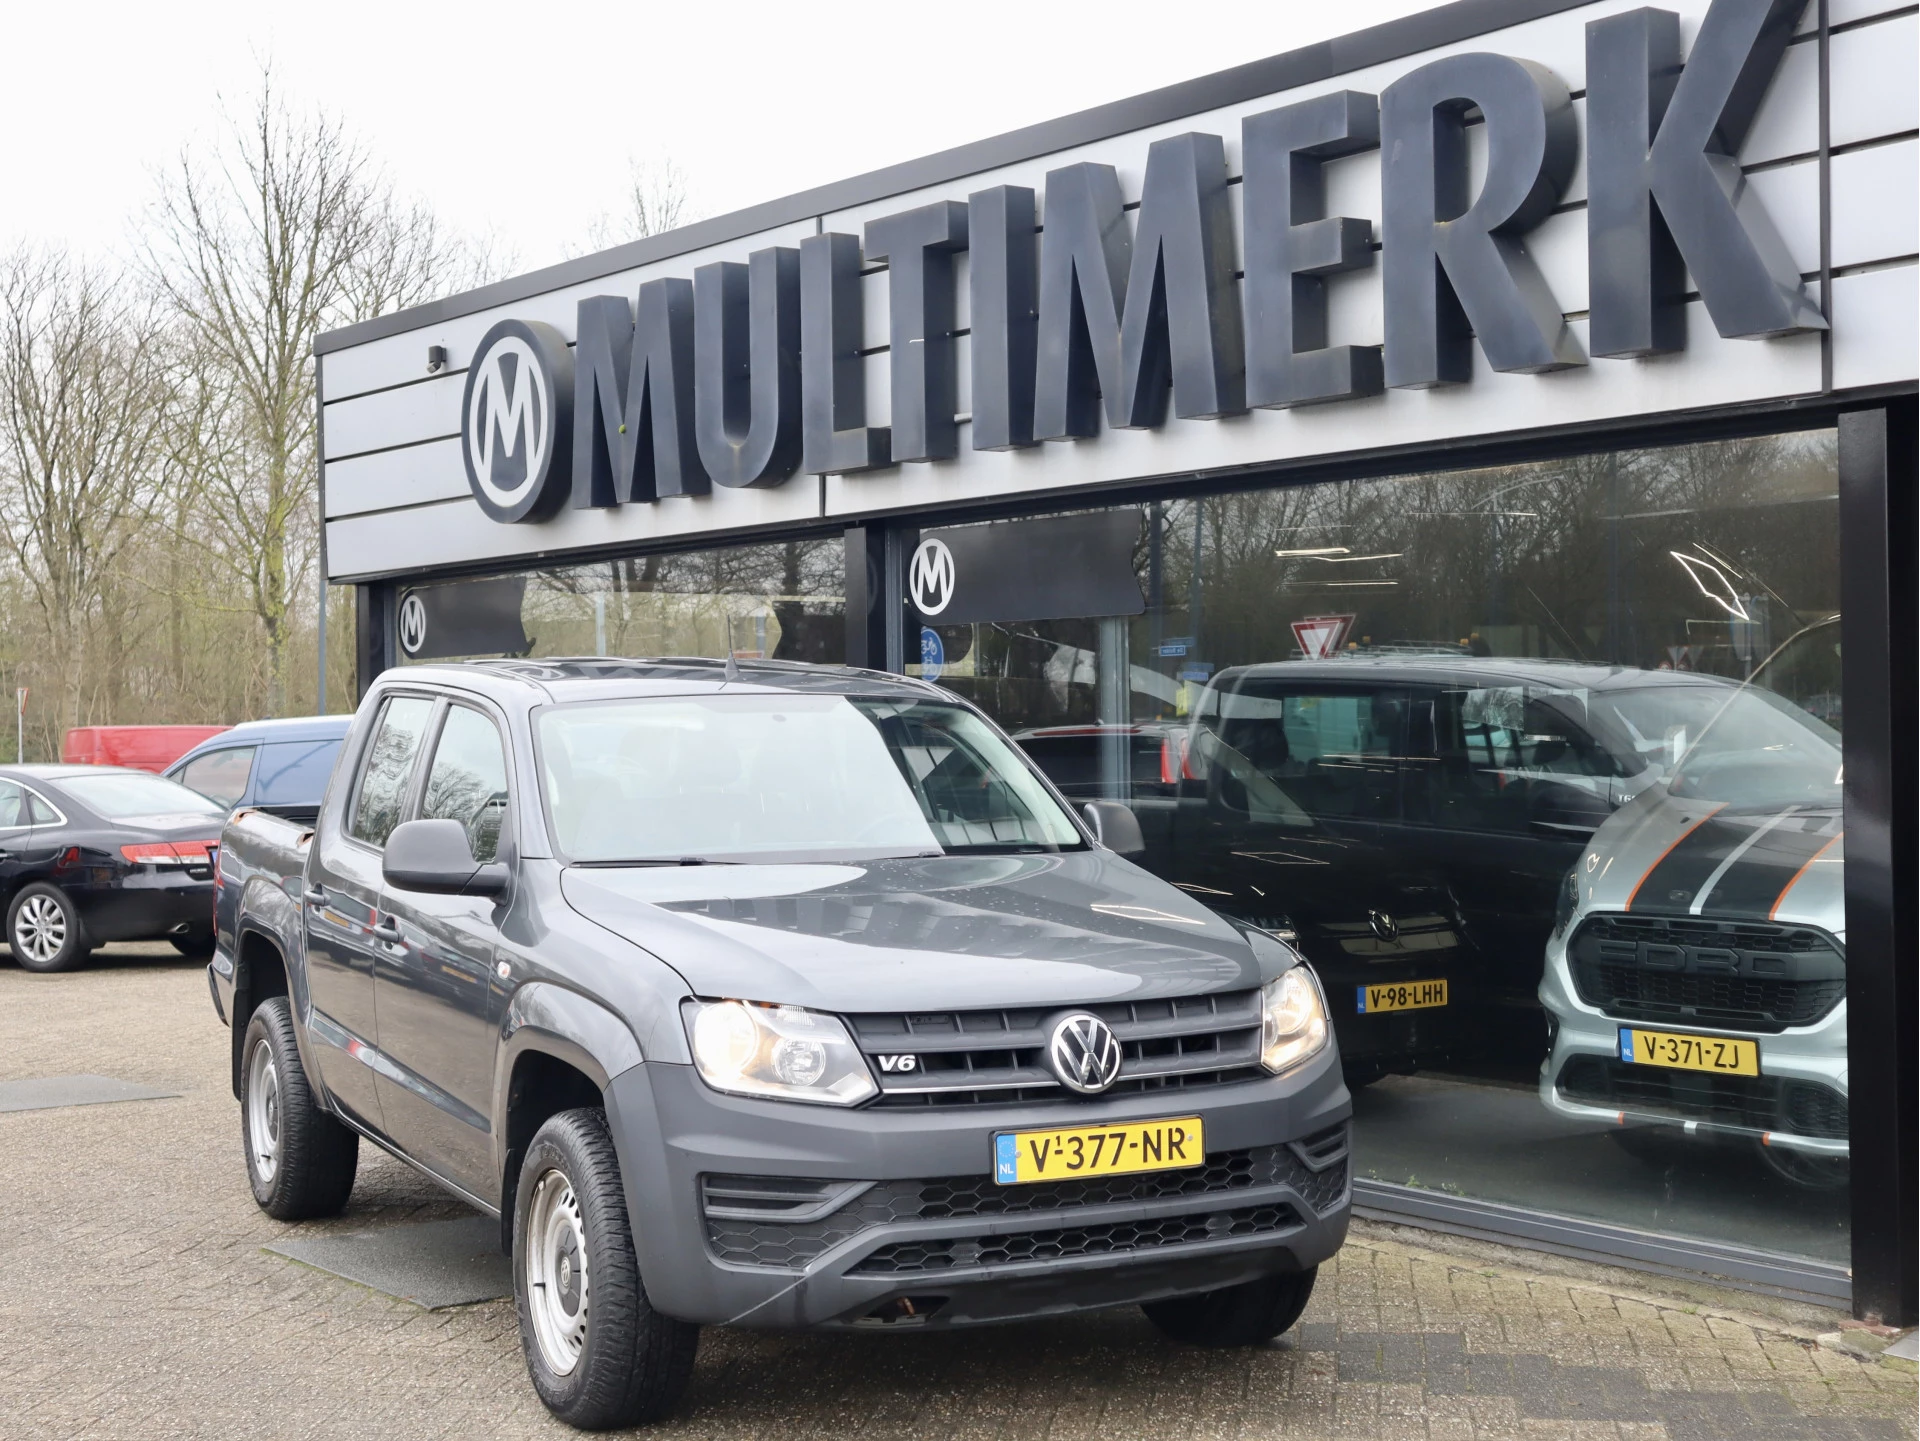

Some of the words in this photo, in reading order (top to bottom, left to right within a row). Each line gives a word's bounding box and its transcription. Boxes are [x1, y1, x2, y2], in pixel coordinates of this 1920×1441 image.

[572, 0, 1830, 510] MULTIMERK
[909, 538, 955, 615] M
[400, 595, 426, 652] M
[1617, 794, 1636, 803] T6
[1599, 938, 1795, 981] FORD
[1371, 983, 1443, 1009] V-98-LHH
[878, 1055, 915, 1072] V6
[1623, 1048, 1632, 1057] NL
[1643, 1035, 1740, 1069] V-371-ZJ
[1000, 1163, 1014, 1174] NL
